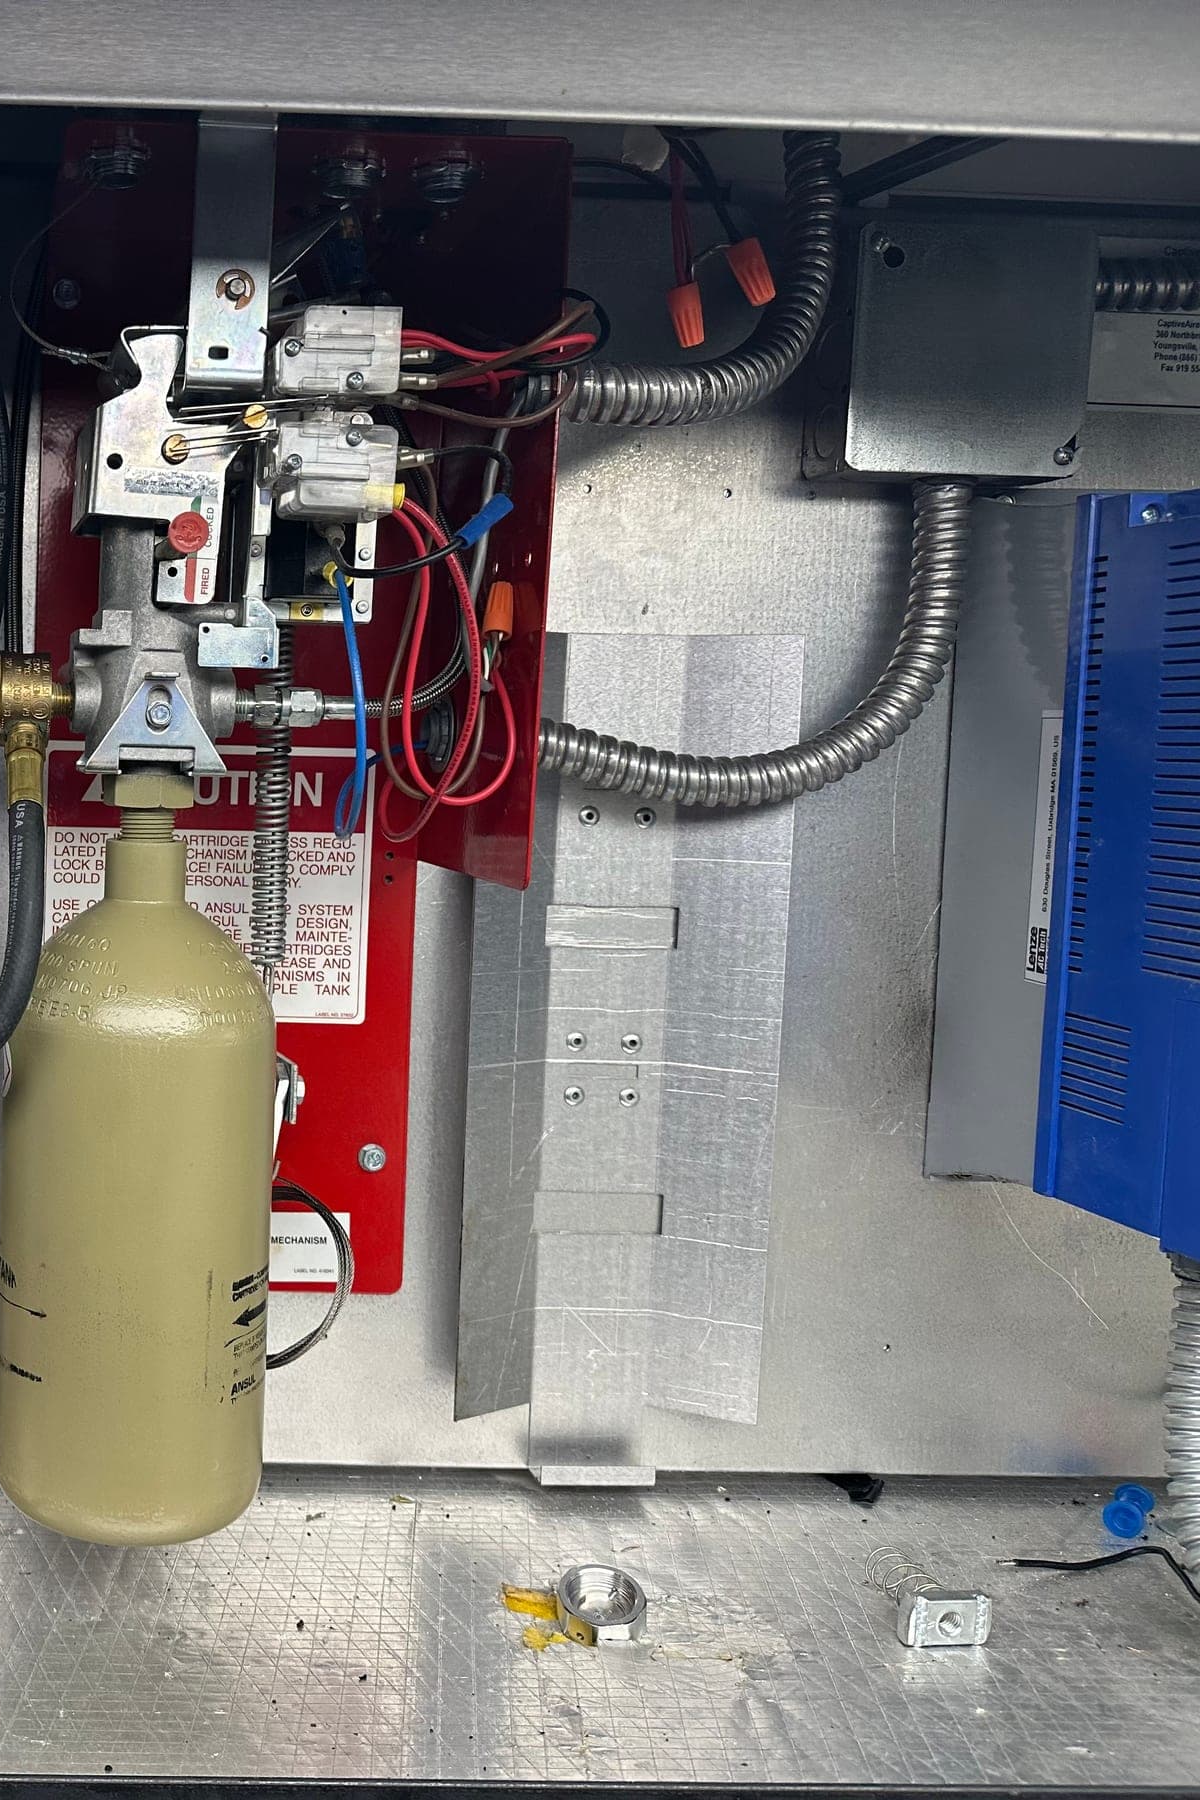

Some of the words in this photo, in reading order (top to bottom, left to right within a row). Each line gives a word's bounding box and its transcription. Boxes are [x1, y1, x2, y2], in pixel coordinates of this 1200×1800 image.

[1154, 352, 1178, 361] Phone
[200, 568, 210, 595] FIRED
[1052, 734, 1059, 748] US
[1050, 780, 1056, 793] MA
[14, 804, 26, 828] USA
[1047, 794, 1056, 832] Uxbridge
[54, 832, 74, 844] DO
[80, 832, 108, 844] NOT
[313, 838, 356, 849] REGU-
[54, 846, 96, 857] LATED
[186, 848, 246, 860] CHANISM
[286, 850, 324, 862] CKED
[326, 852, 356, 863] AND
[54, 859, 90, 870] LOCK
[216, 862, 252, 874] FAILU
[300, 864, 356, 876] COMPLY
[53, 872, 100, 884] COULD
[186, 875, 249, 888] ERSONAL
[1043, 862, 1051, 895] Douglas
[52, 899, 80, 910] USE
[204, 902, 250, 914] ANSUL
[298, 904, 353, 916] SYSTEM
[208, 916, 239, 928] SUL
[296, 918, 352, 931] DESIGN,
[295, 931, 352, 943] MAINTE-
[1038, 930, 1047, 953] Tech
[1026, 926, 1038, 972] Lenze
[274, 958, 316, 969] LEASE
[322, 958, 351, 970] AND
[273, 971, 325, 982] ANISMS
[337, 972, 350, 982] IN
[314, 984, 350, 996] TANK
[270, 1236, 328, 1245] MECHANISM
[230, 1374, 256, 1396] ANSUL
